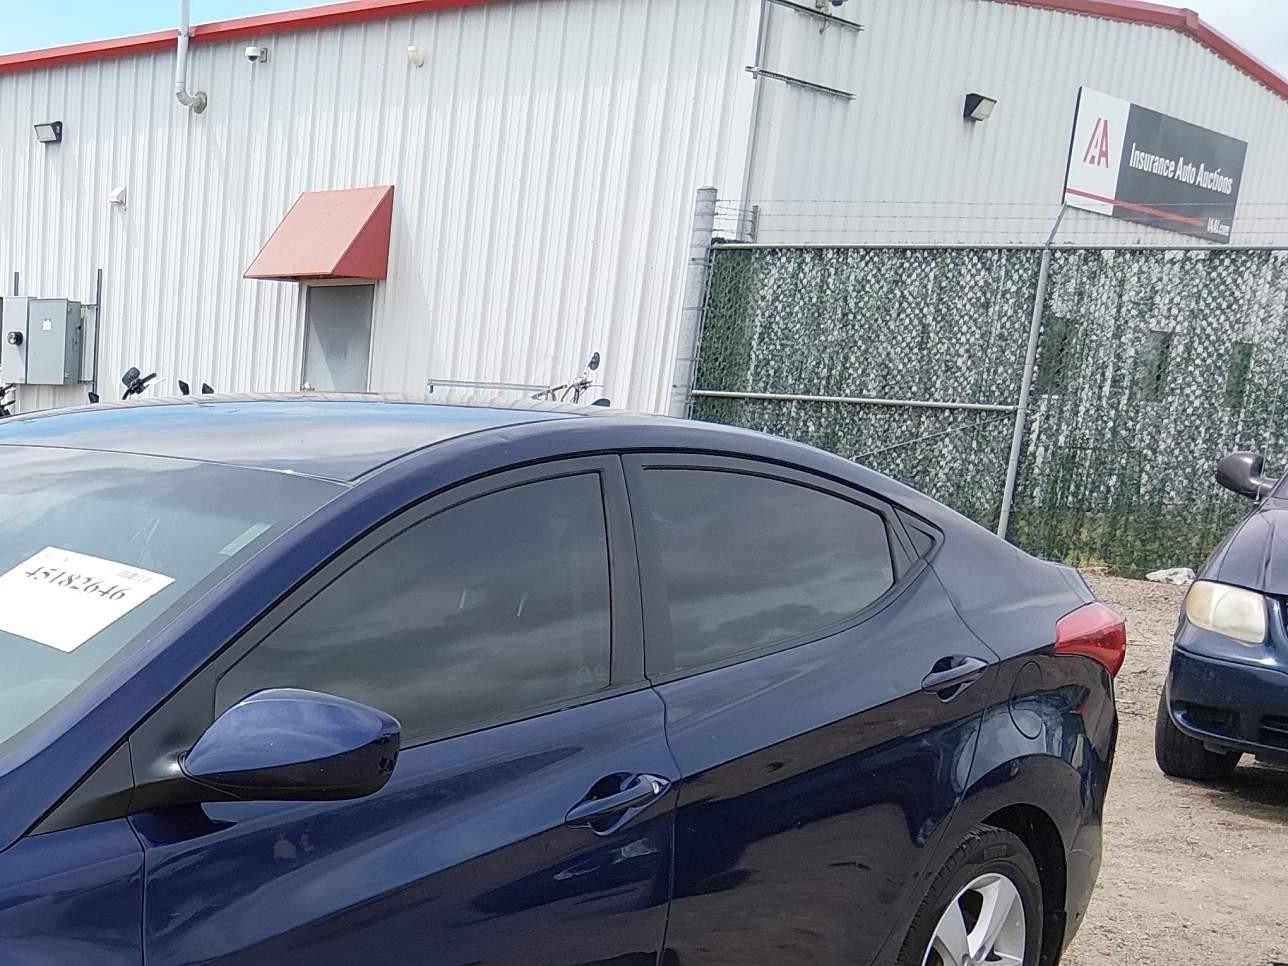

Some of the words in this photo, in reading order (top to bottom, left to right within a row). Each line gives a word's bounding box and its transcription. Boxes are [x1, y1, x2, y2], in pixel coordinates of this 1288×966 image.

[1129, 142, 1174, 179] Insurance
[1174, 156, 1196, 184] Auto
[1195, 163, 1234, 195] Auctions
[25, 566, 131, 601] 45182646
